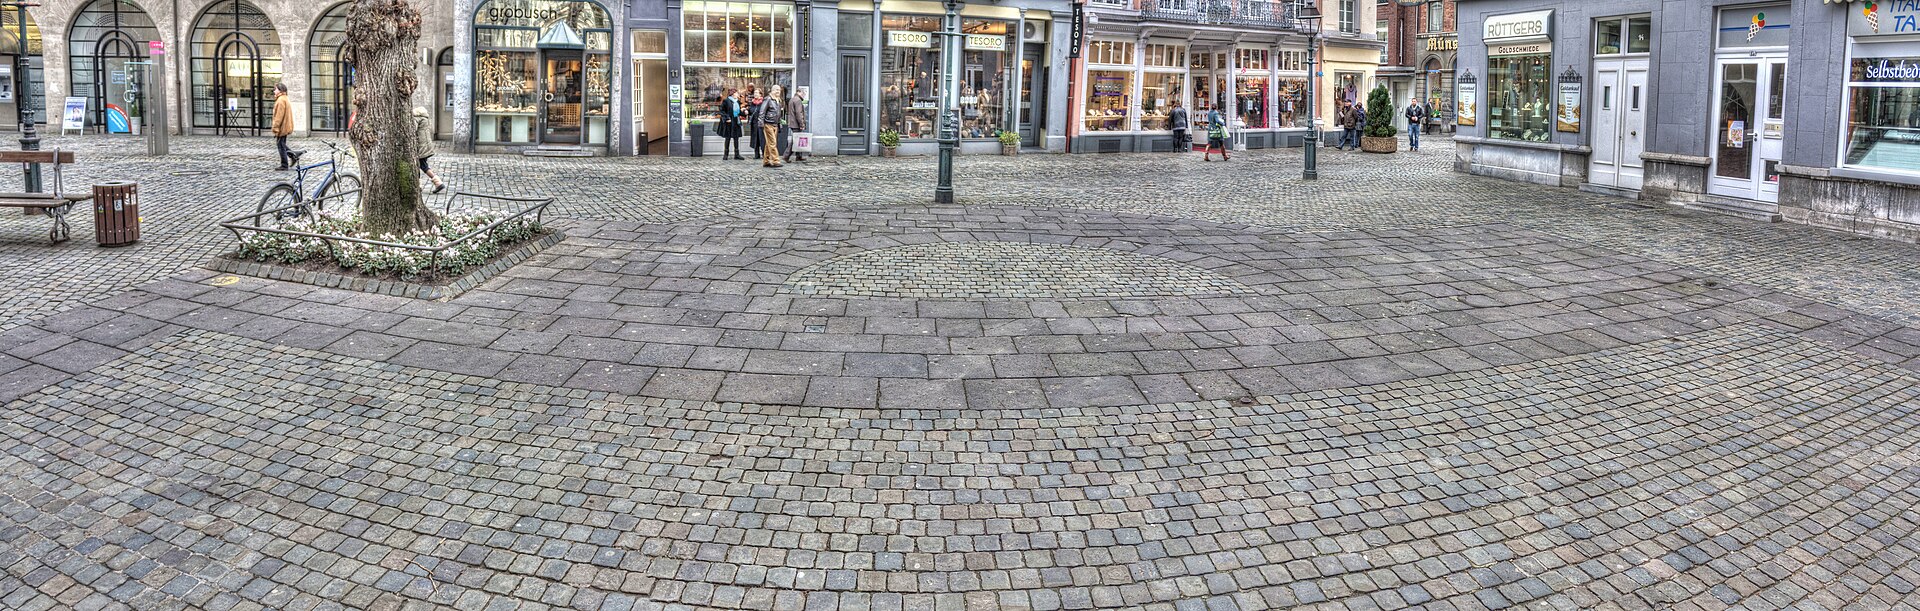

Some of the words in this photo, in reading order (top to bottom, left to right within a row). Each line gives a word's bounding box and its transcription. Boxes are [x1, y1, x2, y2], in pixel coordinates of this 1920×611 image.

[489, 6, 557, 22] grobusch
[1487, 19, 1543, 37] RÖTTGERS
[1894, 15, 1920, 32] TA
[892, 33, 928, 43] TESORO
[969, 36, 1003, 46] TESORO
